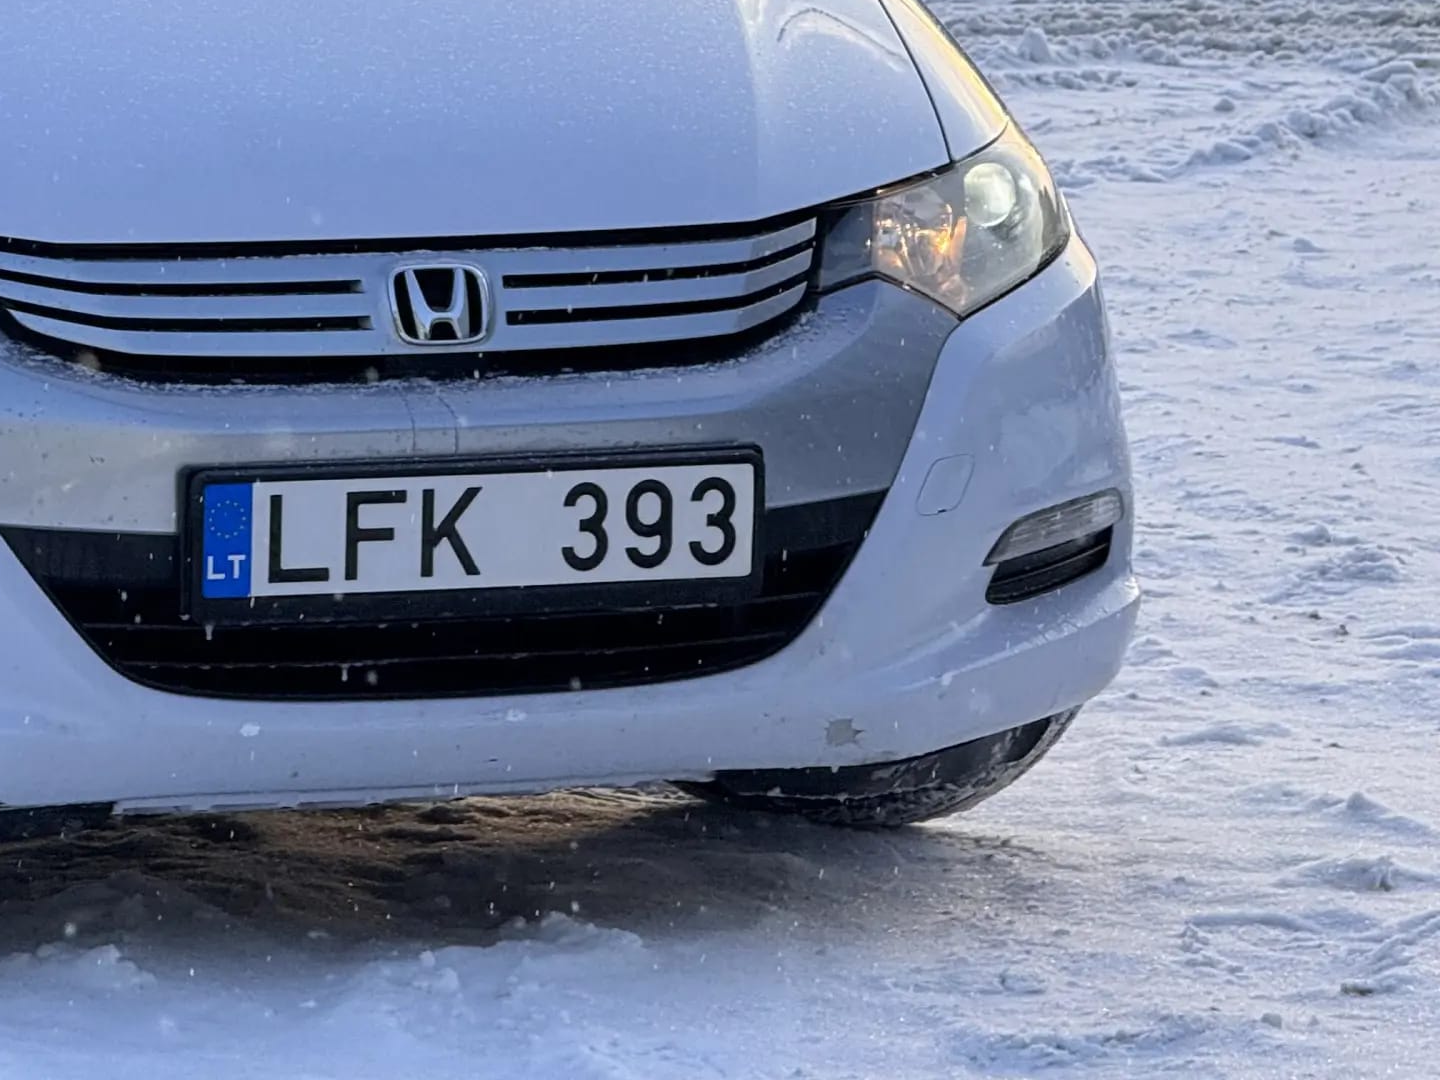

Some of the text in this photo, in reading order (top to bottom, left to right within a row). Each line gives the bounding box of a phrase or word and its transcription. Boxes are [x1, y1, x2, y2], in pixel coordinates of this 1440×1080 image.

[267, 476, 737, 584] LFK 393
[206, 553, 247, 581] LT
